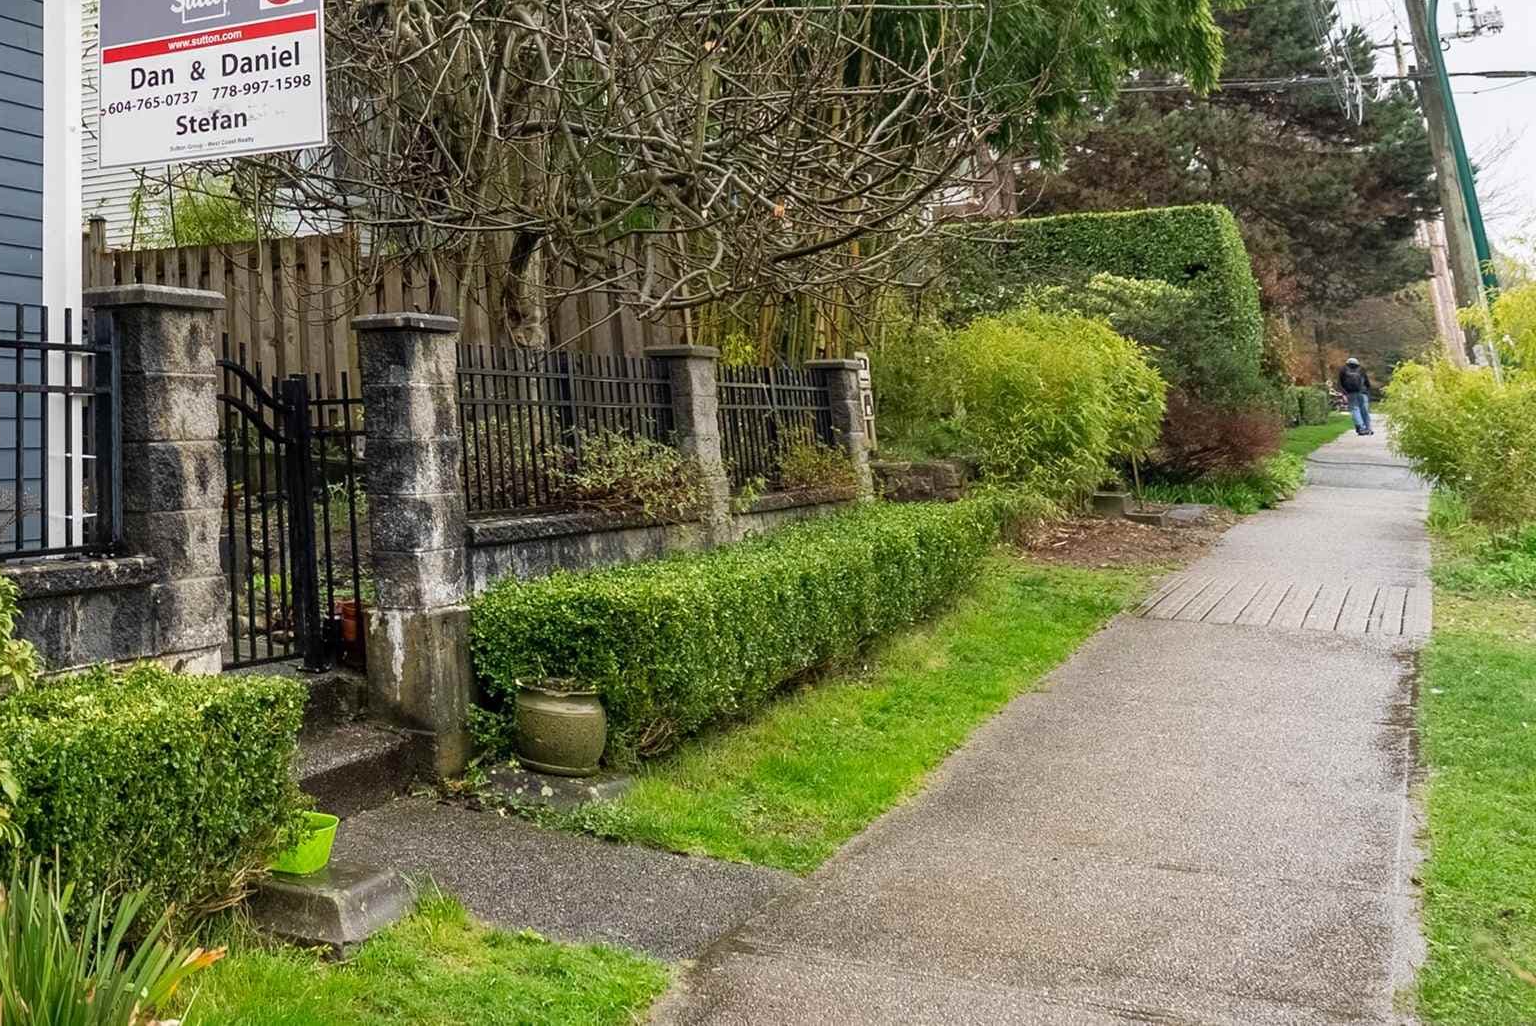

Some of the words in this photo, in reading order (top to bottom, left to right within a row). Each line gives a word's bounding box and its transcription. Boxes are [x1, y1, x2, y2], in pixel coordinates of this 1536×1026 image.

[167, 30, 243, 50] www.sutton.com
[131, 67, 174, 90] Dan
[190, 60, 206, 81] &
[221, 41, 300, 77] Daniel
[108, 90, 199, 115] 604-765-0737
[212, 73, 312, 100] 778-997-1598
[175, 109, 248, 136] Stefan
